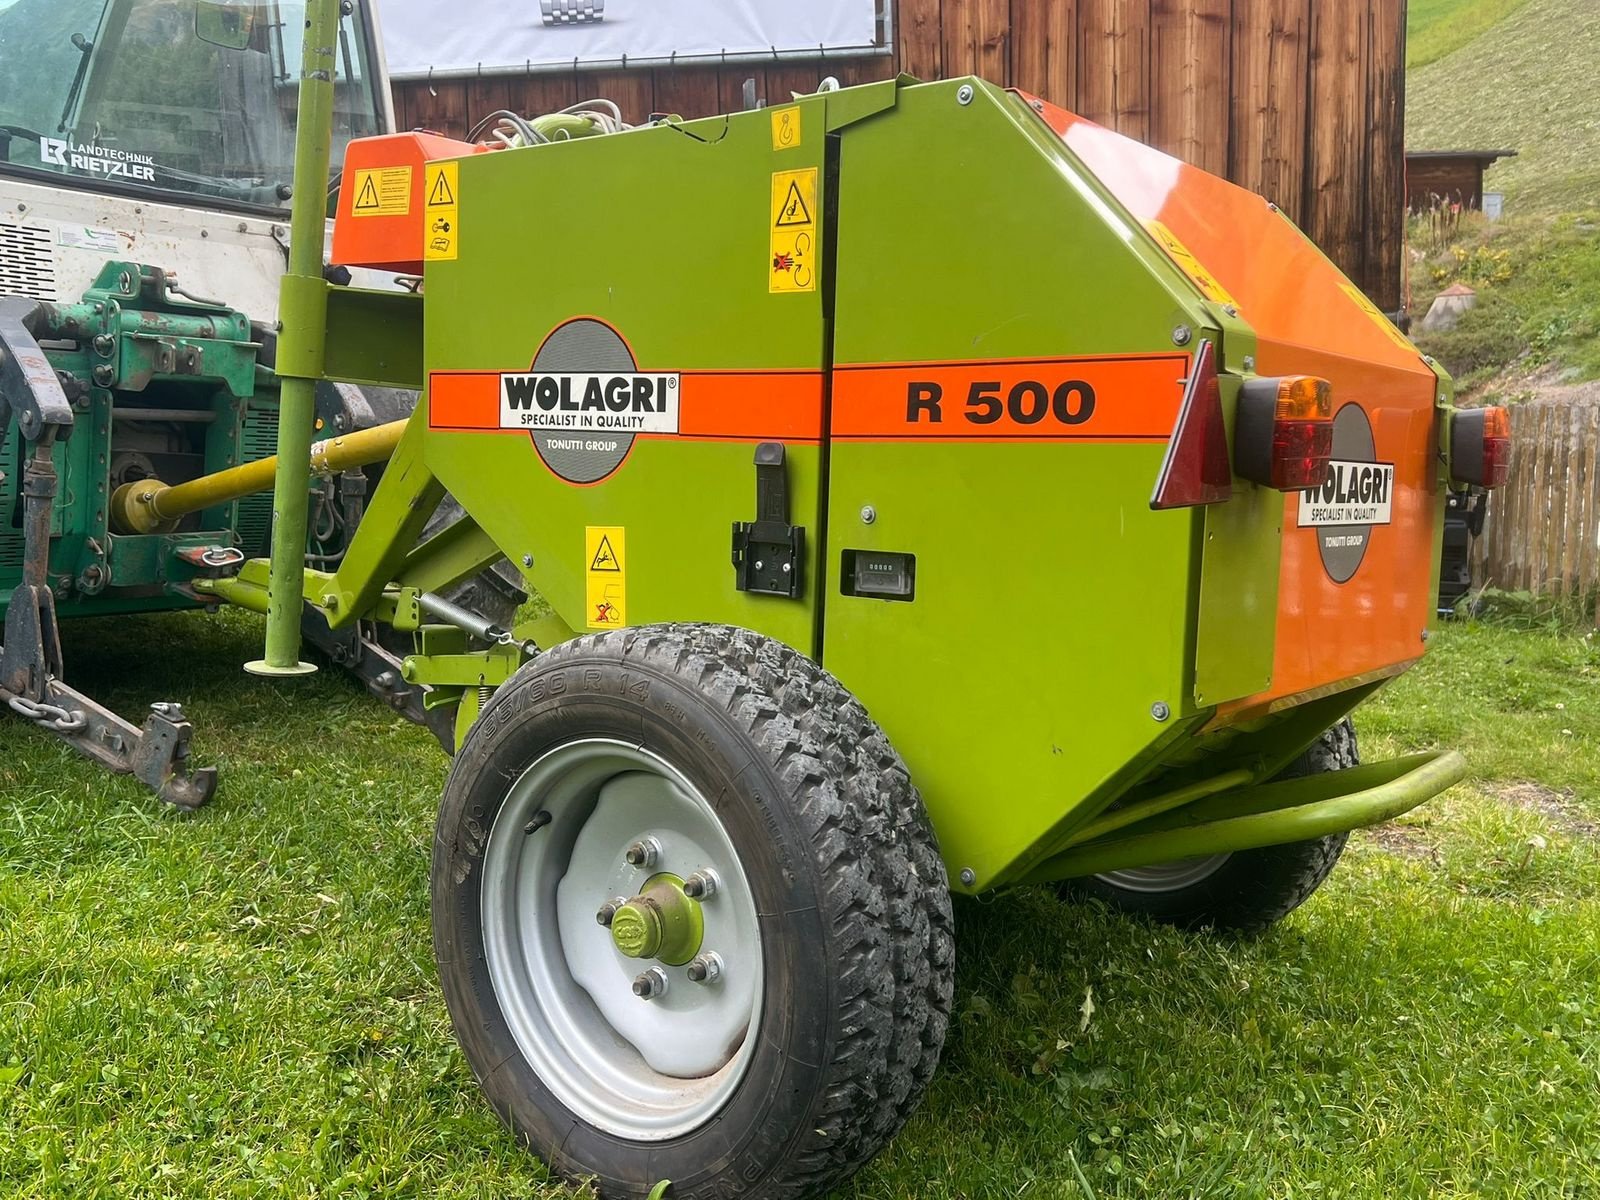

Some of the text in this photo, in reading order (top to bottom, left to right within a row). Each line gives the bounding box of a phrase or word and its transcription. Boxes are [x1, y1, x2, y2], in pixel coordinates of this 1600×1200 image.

[70, 142, 154, 165] LANDTECHNIK
[70, 153, 155, 181] RIETZLER
[906, 380, 1096, 425] R 500
[521, 413, 645, 429] SPECIALIST IN QUALITY
[547, 439, 617, 452] TONUTTI GROUP
[1312, 508, 1377, 521] SPECIALIST IN QUALITY
[1346, 535, 1363, 547] GROUP
[584, 668, 603, 692] R
[618, 673, 651, 702] 14
